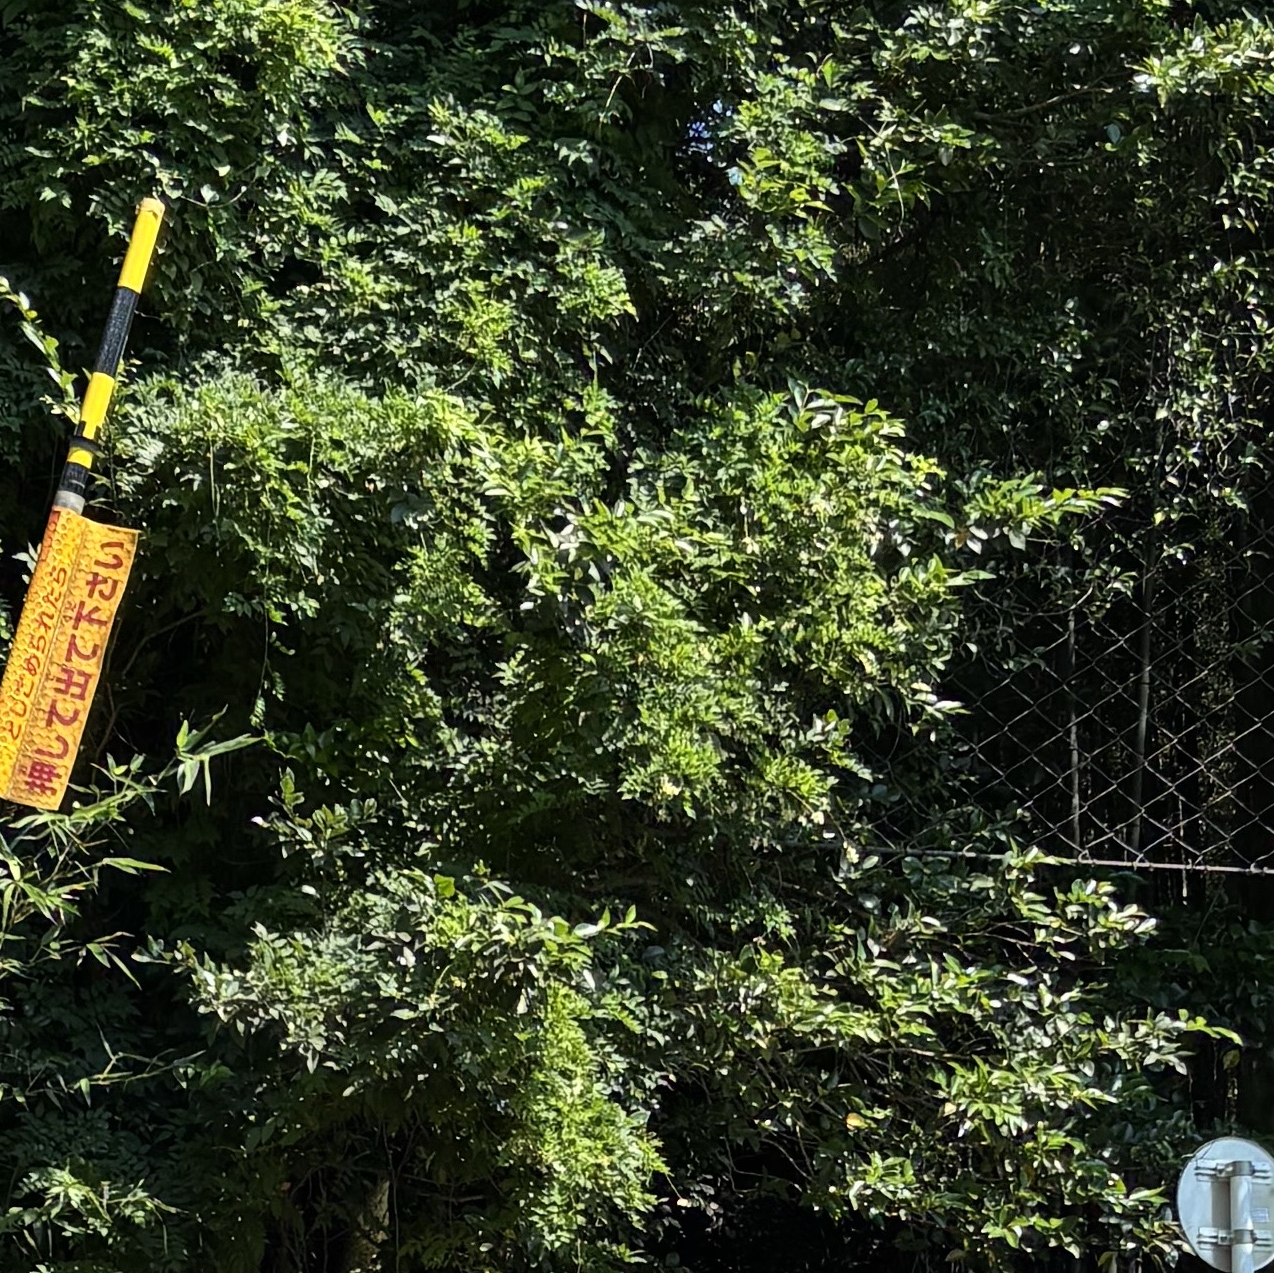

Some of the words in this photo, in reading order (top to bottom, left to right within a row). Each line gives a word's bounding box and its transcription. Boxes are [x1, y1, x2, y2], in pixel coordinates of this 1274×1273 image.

[25, 541, 124, 797] 押して出て下さい
